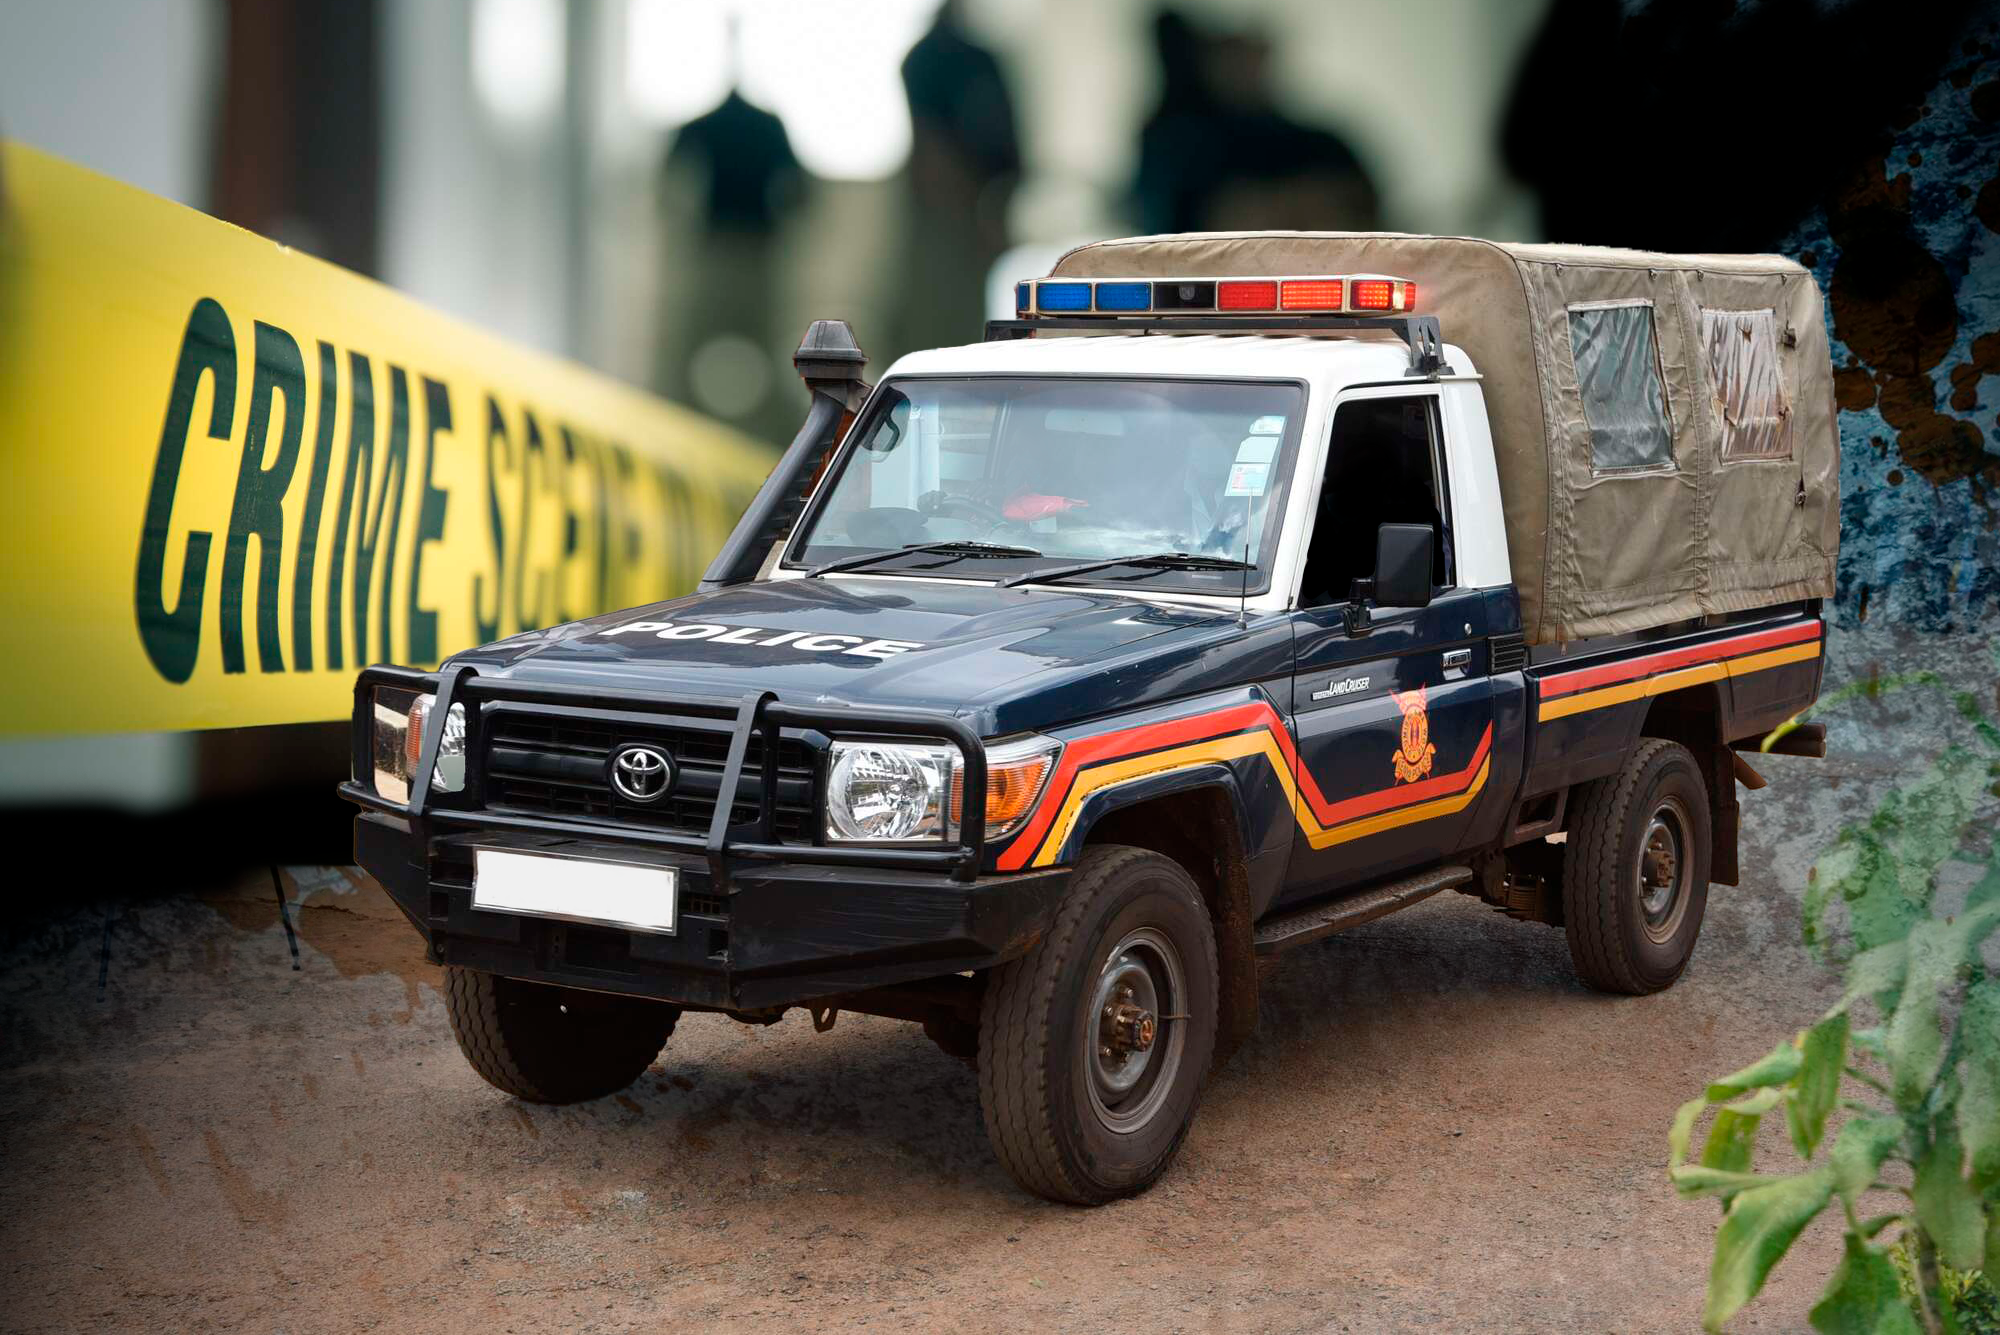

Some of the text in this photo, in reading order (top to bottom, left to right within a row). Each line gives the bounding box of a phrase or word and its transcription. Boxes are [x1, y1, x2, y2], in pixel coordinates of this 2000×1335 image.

[135, 297, 455, 684] CRIME
[473, 391, 644, 644] SCE
[597, 621, 926, 660] POLICE
